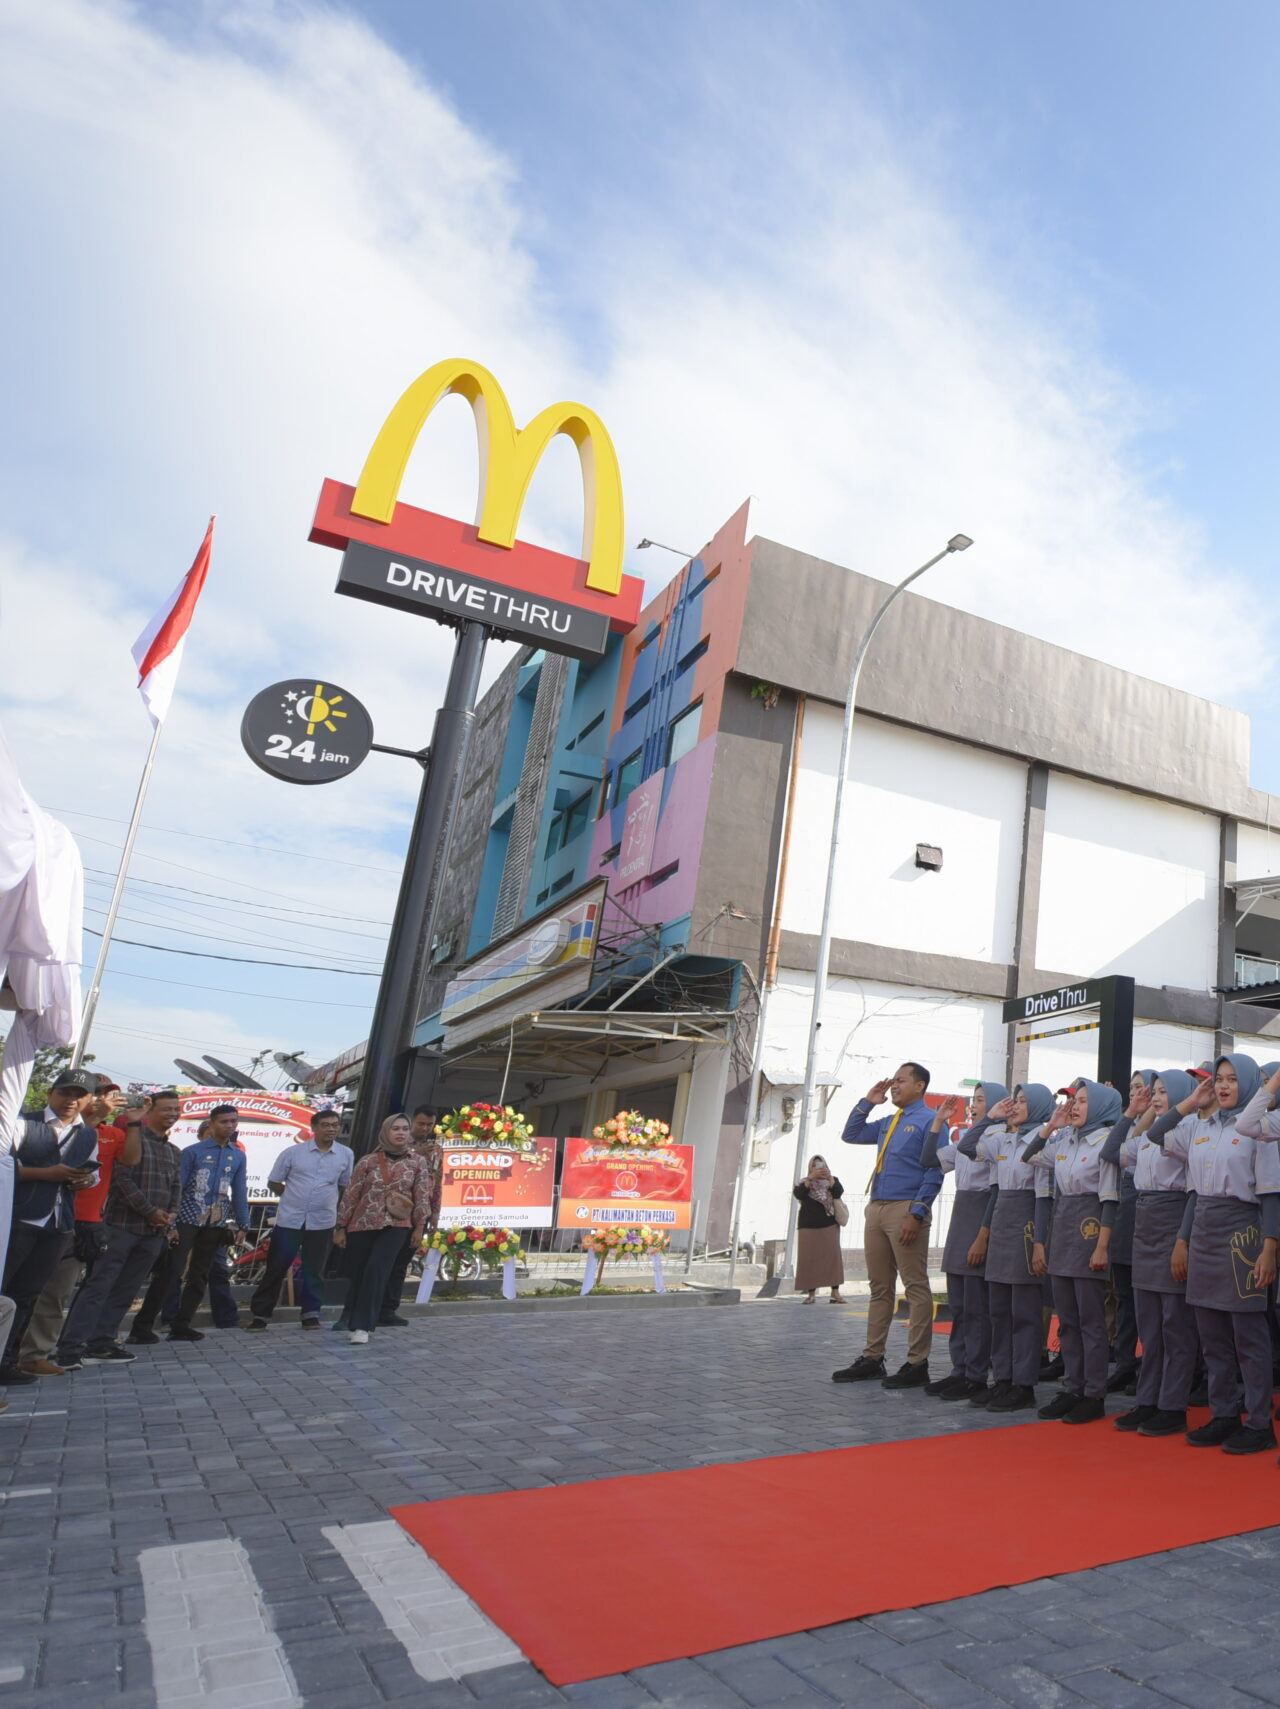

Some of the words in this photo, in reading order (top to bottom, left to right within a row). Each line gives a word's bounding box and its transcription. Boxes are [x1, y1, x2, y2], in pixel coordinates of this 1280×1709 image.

[264, 734, 316, 763] 24
[319, 749, 350, 765] jam
[238, 1128, 269, 1138] pening
[447, 1154, 513, 1168] GRAND
[606, 1162, 627, 1170] GRAND
[453, 1170, 501, 1180] OPENING
